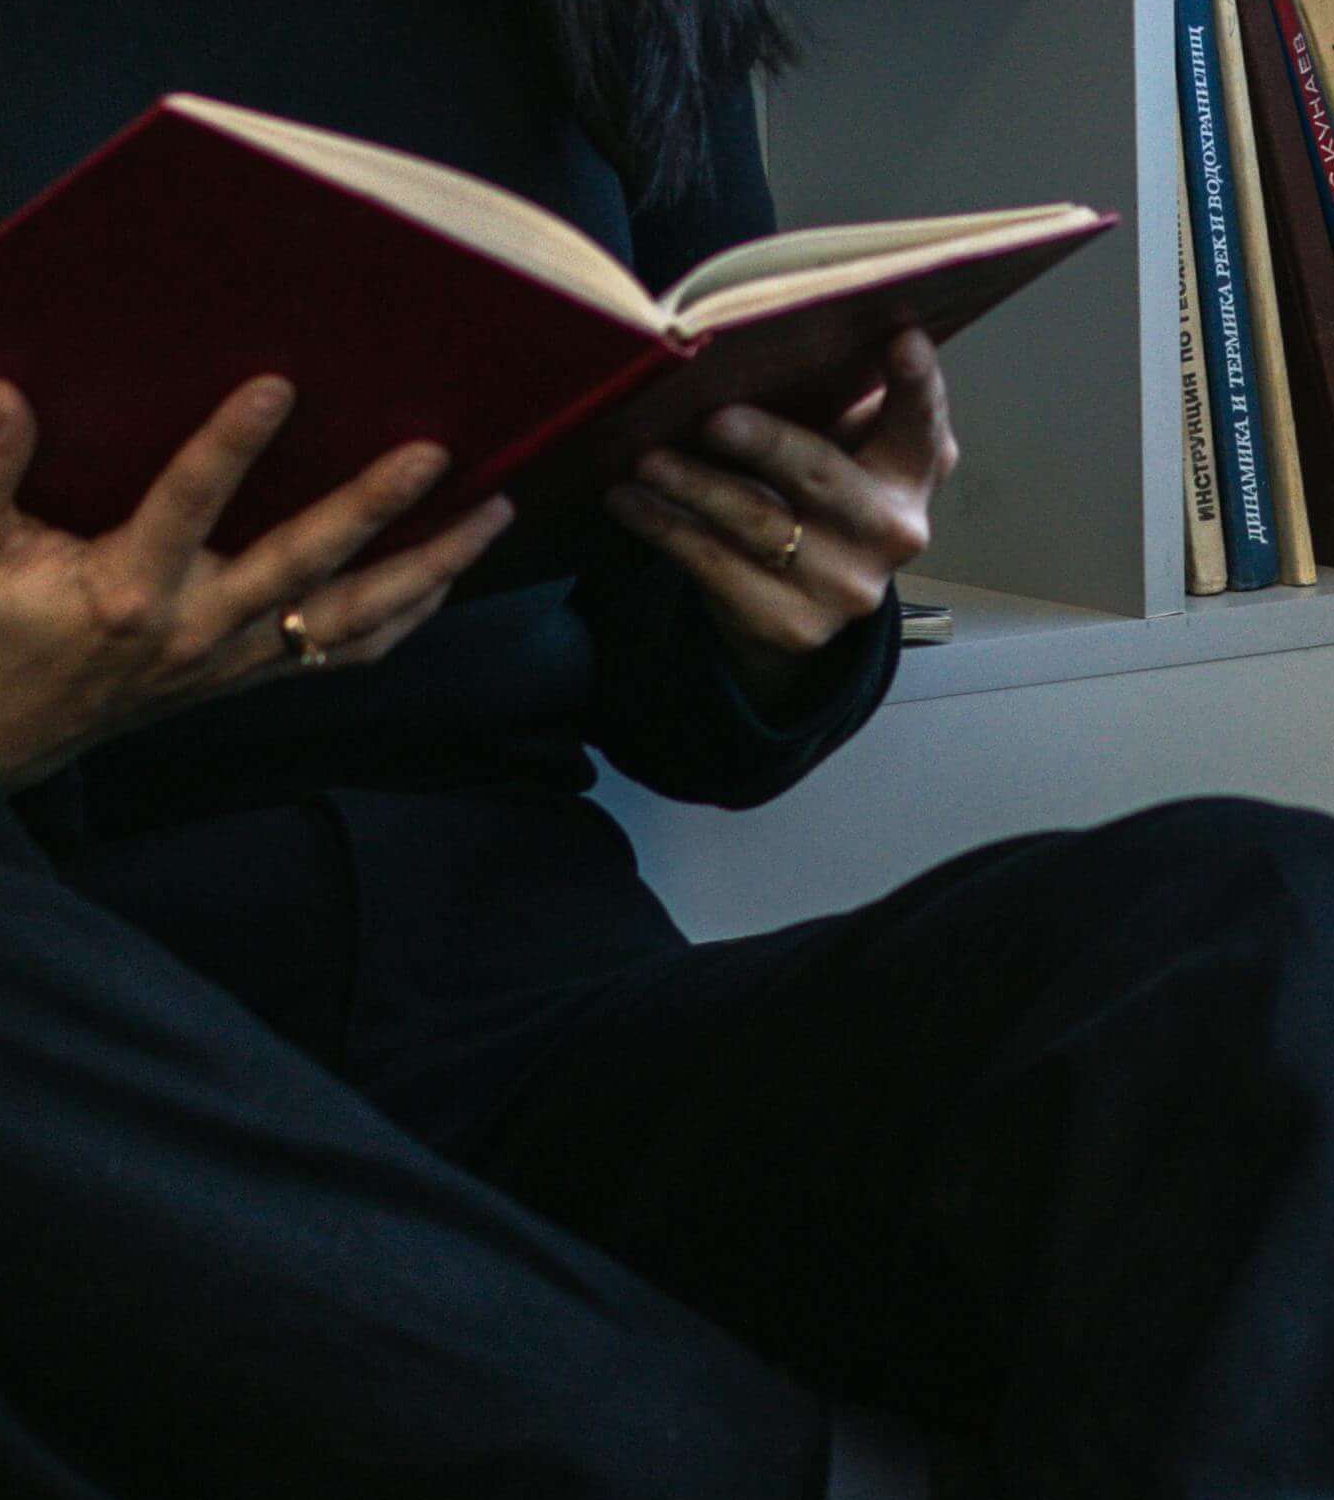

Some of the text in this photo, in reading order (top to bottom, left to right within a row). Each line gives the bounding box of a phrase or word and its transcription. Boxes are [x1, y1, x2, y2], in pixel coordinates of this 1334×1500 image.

[1180, 371, 1216, 521] ИНСТРУКЦИЯ
[1187, 23, 1269, 545] ДИНАМИКА И ТЕРМИКА РЕК И ВОДОХРАНИЛИЩ
